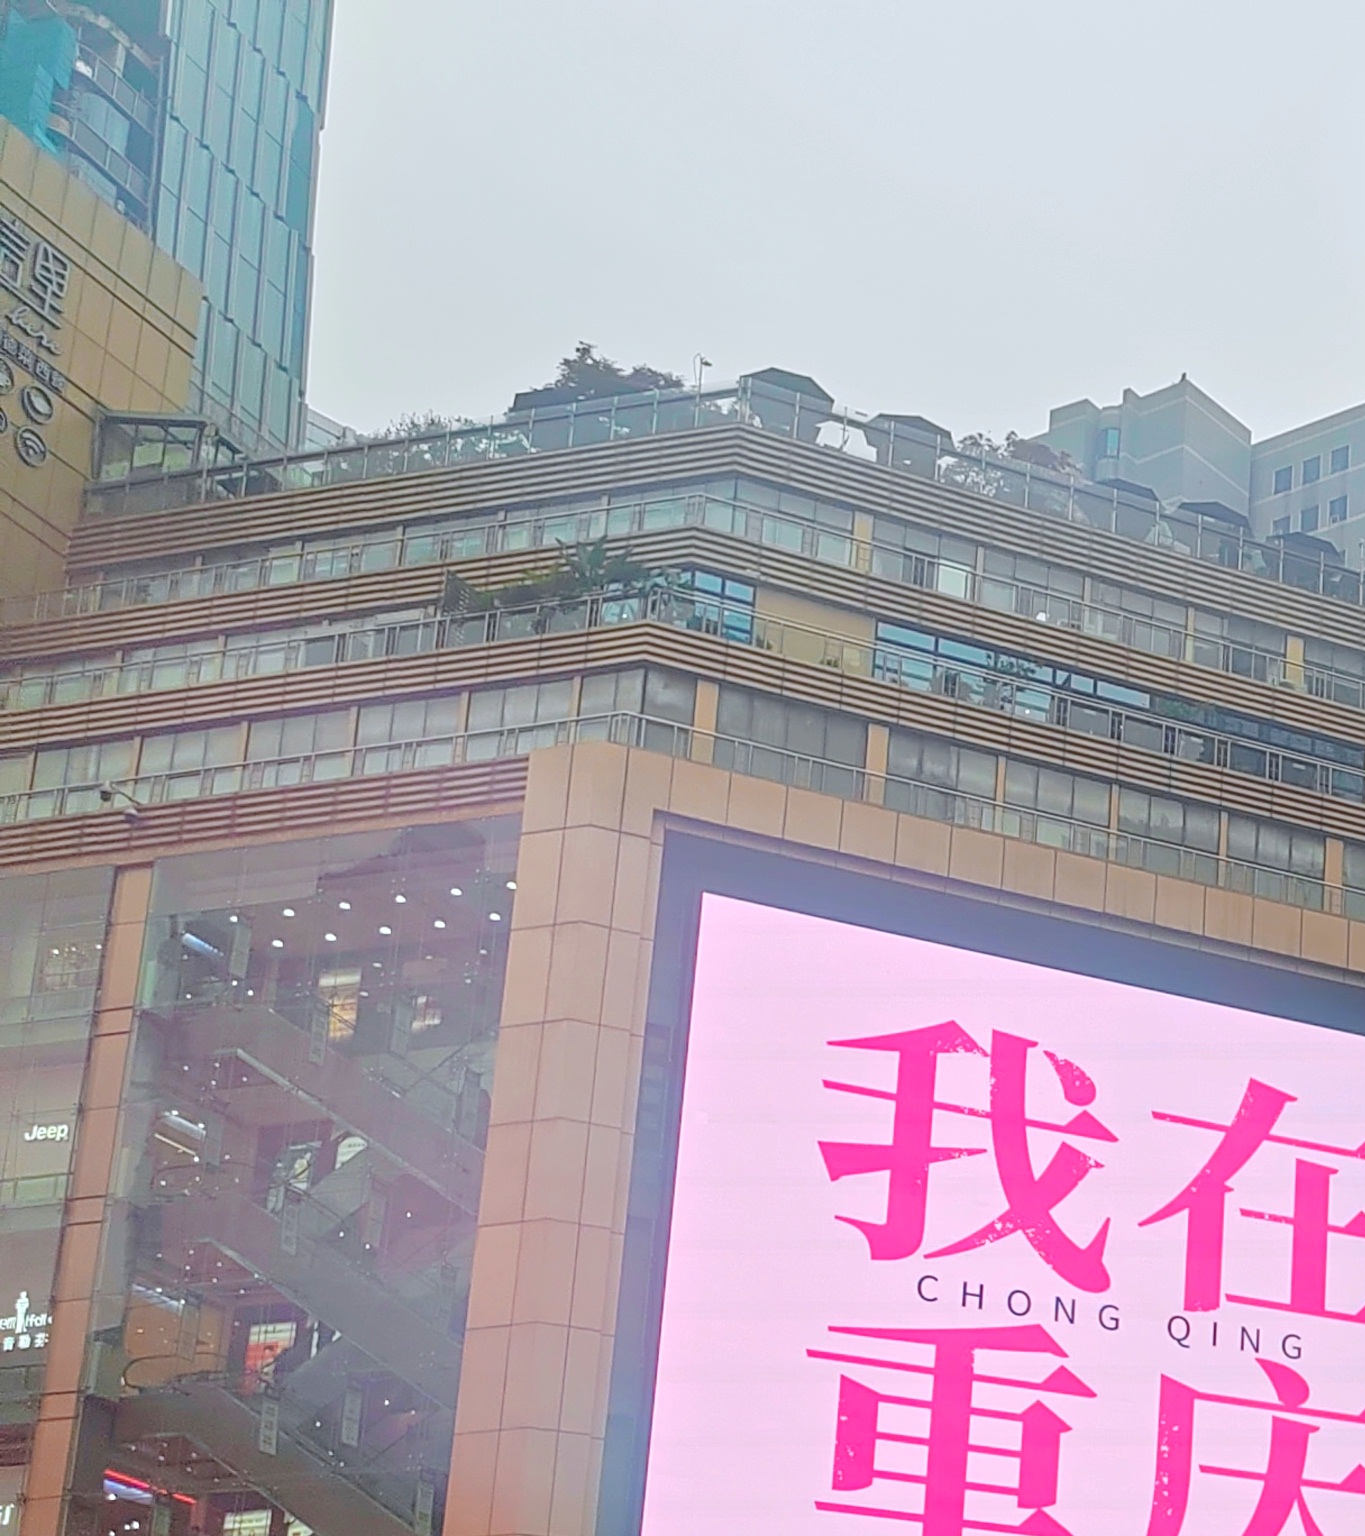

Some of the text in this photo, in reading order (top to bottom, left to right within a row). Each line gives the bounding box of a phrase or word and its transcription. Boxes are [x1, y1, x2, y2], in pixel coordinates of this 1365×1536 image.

[24, 1123, 69, 1141] Jeep
[915, 1272, 1307, 1360] CHONG QING
